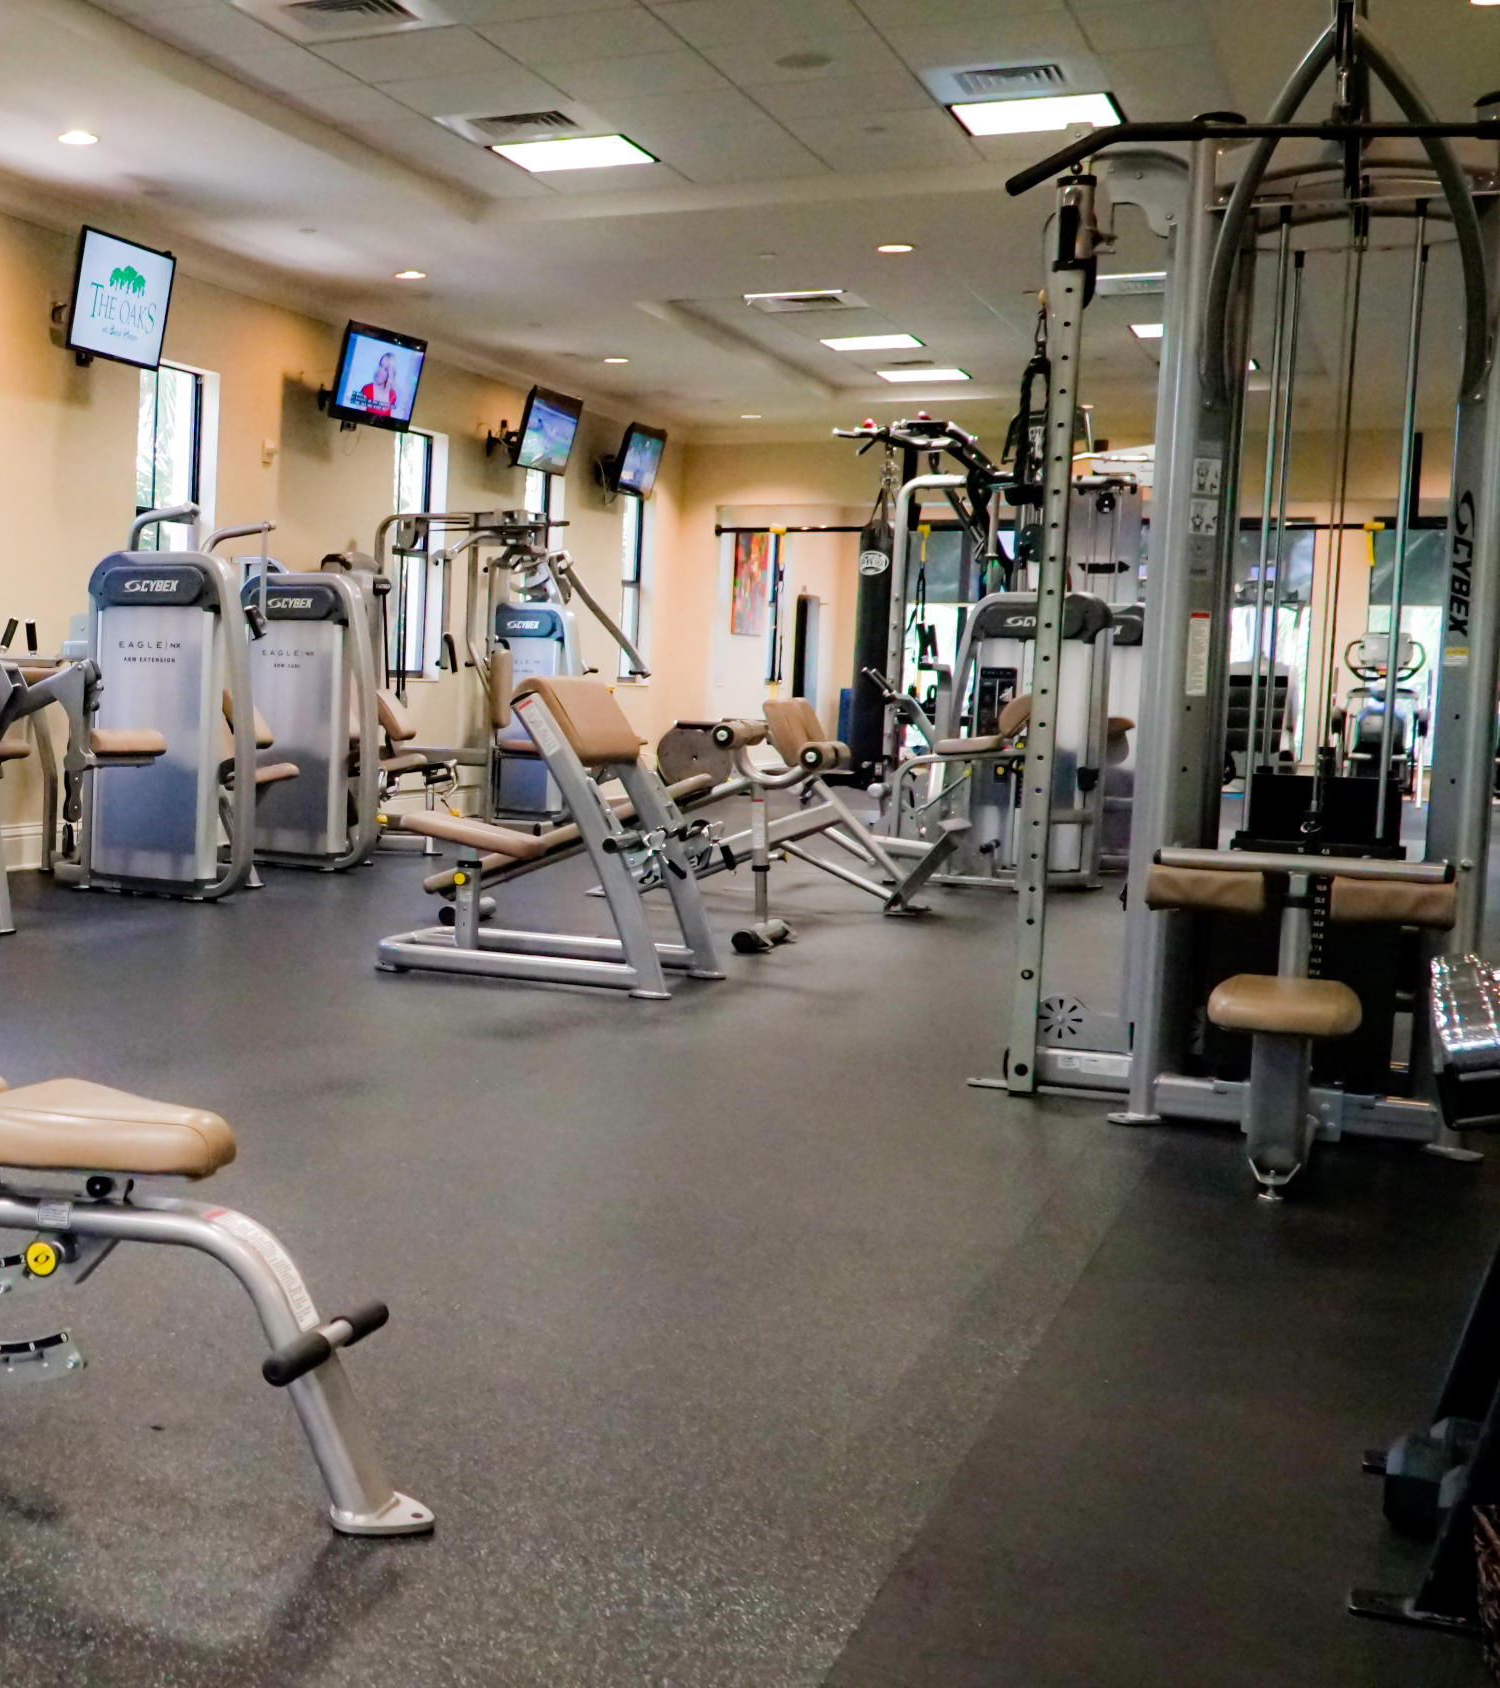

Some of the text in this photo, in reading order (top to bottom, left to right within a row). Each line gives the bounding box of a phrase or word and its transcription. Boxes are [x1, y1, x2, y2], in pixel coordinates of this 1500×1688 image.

[90, 281, 118, 321] THE
[120, 300, 157, 335] OAKS
[140, 579, 179, 592] CYBEX
[1447, 535, 1474, 638] CYBEX
[280, 597, 314, 609] CYBEX
[118, 640, 163, 649] EAGLE
[261, 649, 300, 657] EAGLE
